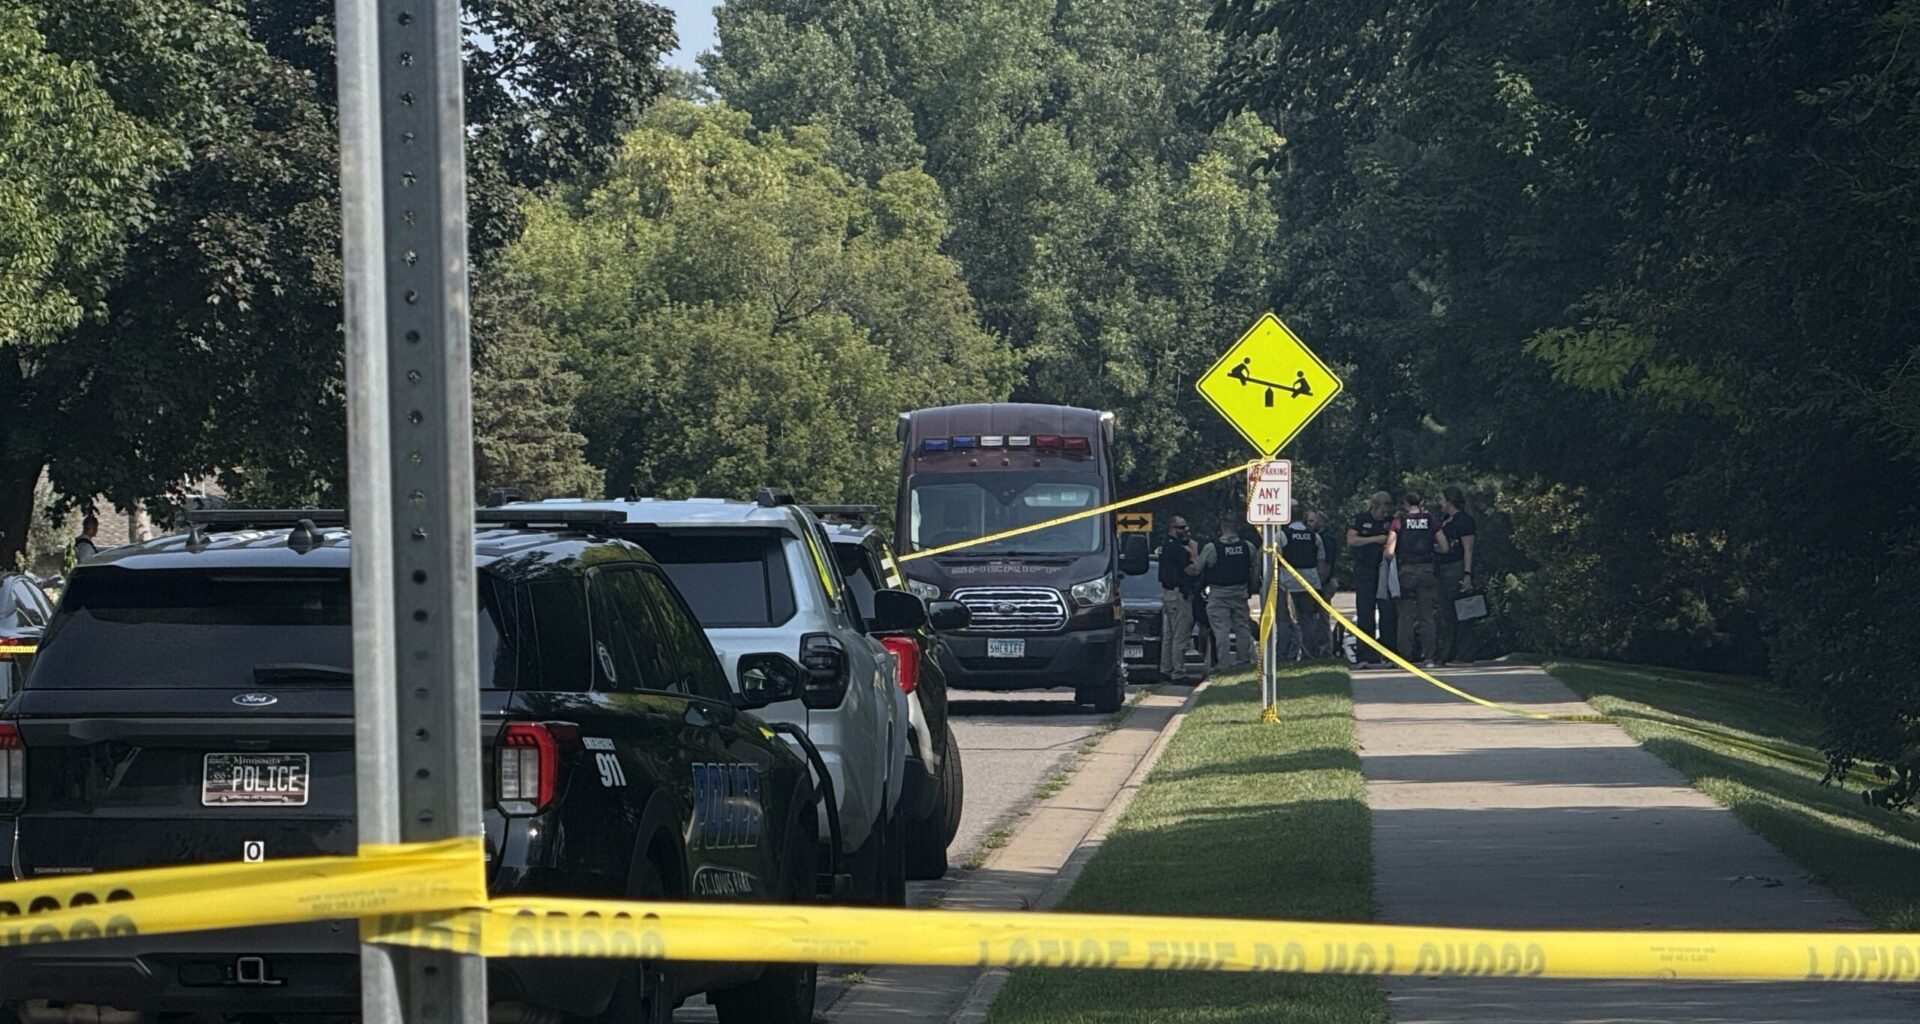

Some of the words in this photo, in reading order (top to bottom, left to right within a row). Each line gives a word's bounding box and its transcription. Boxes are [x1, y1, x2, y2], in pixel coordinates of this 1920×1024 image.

[1258, 487, 1280, 499] ANY
[1257, 503, 1281, 515] TIME
[1406, 519, 1428, 529] POLICE
[1225, 546, 1244, 556] POLICE
[989, 643, 1023, 654] SHERIFF
[595, 752, 627, 787] 911
[232, 766, 300, 792] POLICE
[691, 762, 760, 850] POLICE
